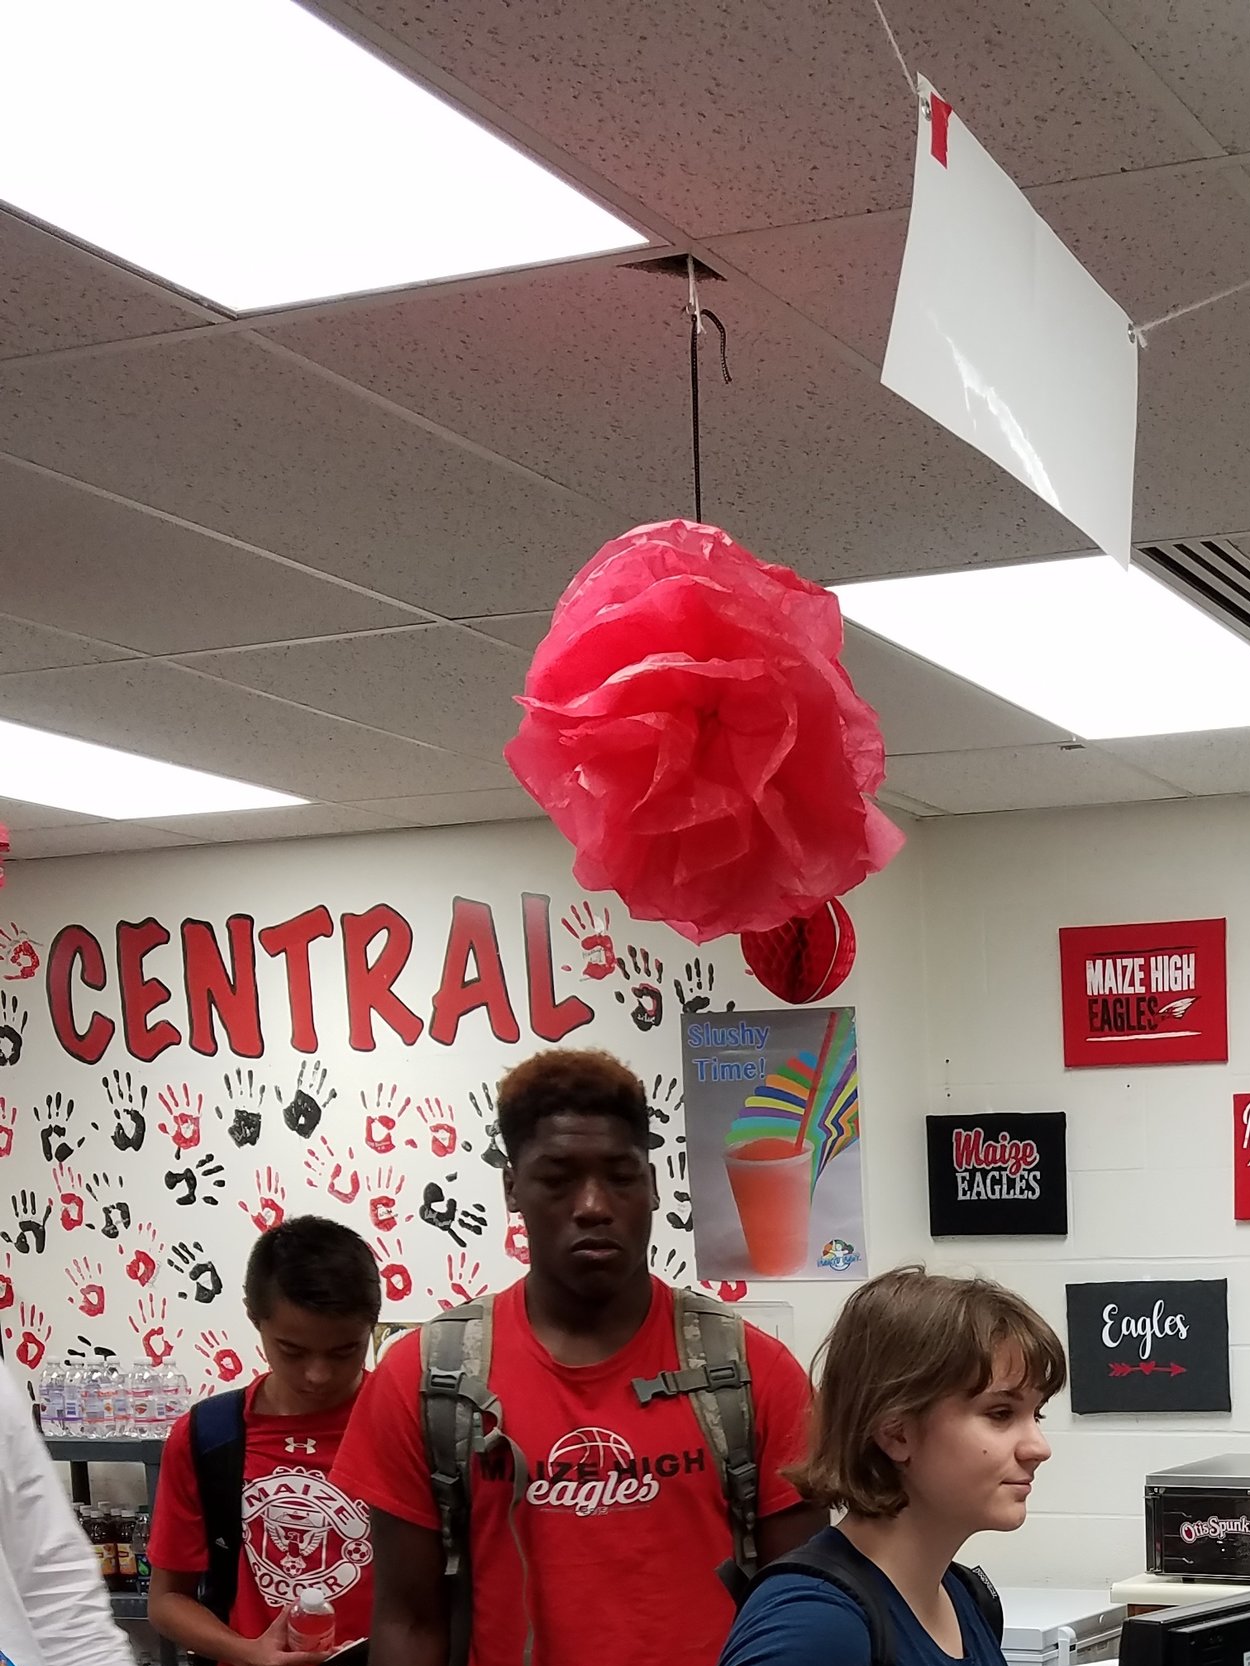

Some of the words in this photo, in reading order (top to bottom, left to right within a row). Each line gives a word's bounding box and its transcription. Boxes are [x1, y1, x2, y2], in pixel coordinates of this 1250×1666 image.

[46, 891, 595, 1065] CENTRAL
[1085, 957, 1146, 996] MAIZE
[1150, 953, 1196, 993] HIGH
[687, 1021, 771, 1050] Slushy
[1088, 996, 1159, 1033] EAGLES
[692, 1057, 767, 1082] Time!
[953, 1128, 1040, 1178] Maize
[955, 1171, 1041, 1200] EAGLES
[1101, 1299, 1190, 1360] Eagles
[477, 1455, 599, 1483] MIZE
[614, 1447, 706, 1481] HIGH
[244, 1483, 356, 1526] MAIZE
[526, 1470, 660, 1517] eagles
